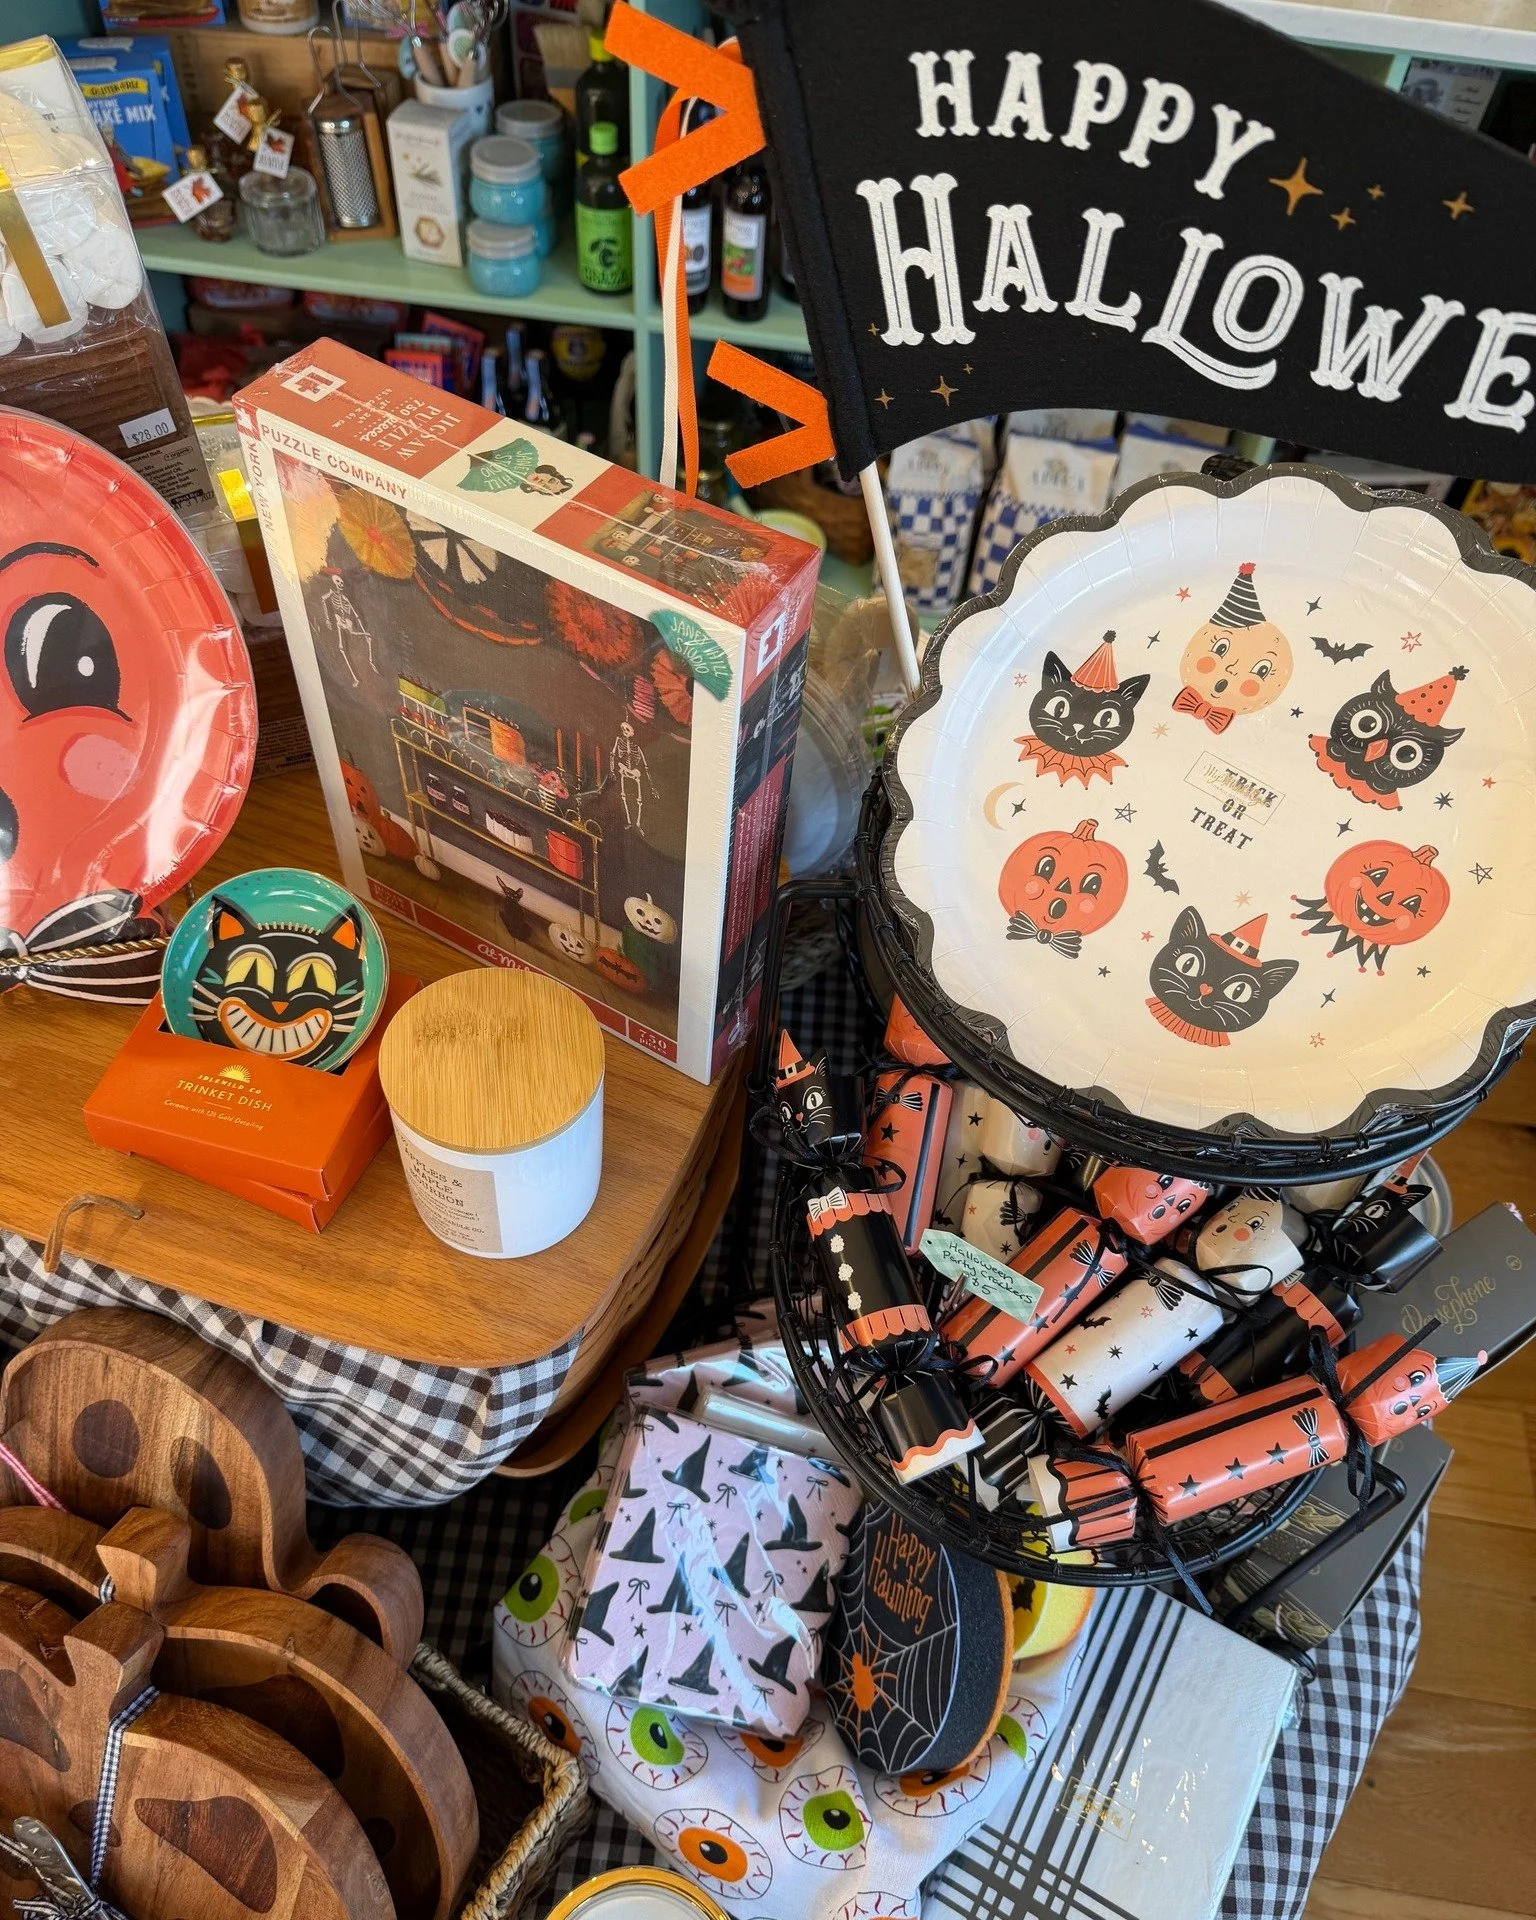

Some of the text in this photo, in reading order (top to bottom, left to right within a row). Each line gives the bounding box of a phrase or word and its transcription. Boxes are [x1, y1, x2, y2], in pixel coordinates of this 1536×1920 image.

[91, 104, 157, 125] AKE MIX
[909, 49, 1276, 200] HAPPY
[856, 172, 1536, 433] HALLOWE
[131, 422, 169, 444] $28.00
[360, 399, 425, 442] 750 pieces
[372, 405, 443, 451] PUZZLE
[396, 412, 463, 461] JIGSAW
[260, 424, 408, 500] PUZZLE COMPANY
[480, 454, 512, 478] STUDIO
[484, 450, 533, 491] JANET HILL
[247, 441, 275, 532] NEW YORK
[670, 617, 729, 678] JANET HILL
[675, 637, 710, 674] STUDIO
[1221, 798, 1247, 820] OR
[1225, 768, 1278, 808] TRICK
[1190, 806, 1254, 850] TREAT
[639, 1029, 667, 1049] 750
[164, 1099, 190, 1110] Ceramic
[191, 1106, 205, 1115] with
[218, 1113, 234, 1122] Gold
[234, 1117, 264, 1131] Detailing
[177, 1080, 272, 1112] TRINKET DISH
[404, 1147, 463, 1188] APPLES &
[409, 1167, 464, 1207] BOURBON
[413, 1164, 453, 1194] MAPLE
[943, 1250, 1033, 1305] Party Crackers
[949, 1241, 1014, 1285] Halloween
[886, 1512, 937, 1583] Happy
[867, 1530, 934, 1636] Haunting
